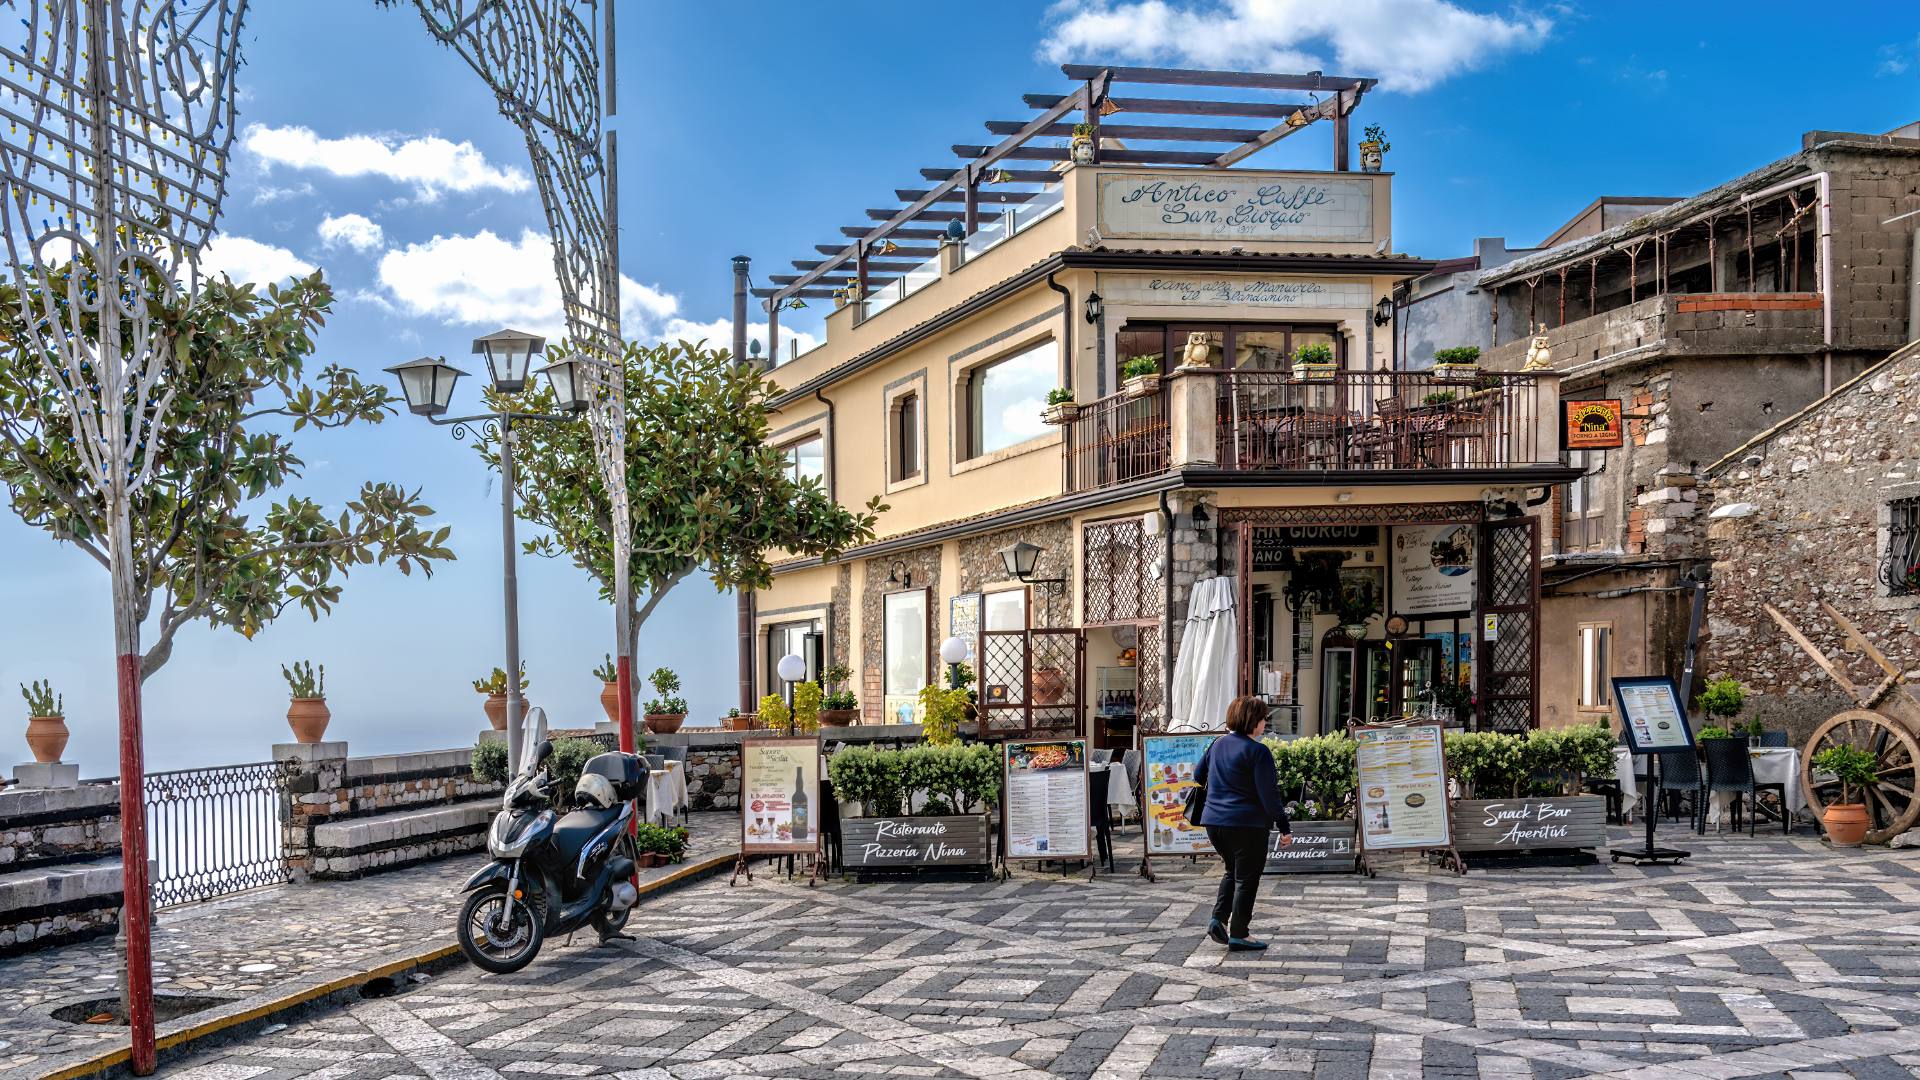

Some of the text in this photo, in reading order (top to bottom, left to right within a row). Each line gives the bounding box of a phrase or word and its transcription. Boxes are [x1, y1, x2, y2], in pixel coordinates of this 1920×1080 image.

[1122, 181, 1237, 203] Antico
[1162, 203, 1311, 231] San Giorgio
[1181, 290, 1200, 301] Il
[1200, 280, 1236, 292] alla
[1244, 281, 1325, 294] Mandorla
[1573, 405, 1614, 424] Pizzeria
[1289, 525, 1360, 538] GIORGIO
[1483, 803, 1571, 826] Snack Bar
[874, 820, 947, 841] Ristorante
[1269, 830, 1329, 851] Trazza
[1495, 822, 1567, 845] Aperitivi
[861, 842, 967, 864] Pizzeria Nina
[1267, 847, 1329, 859] noramica
